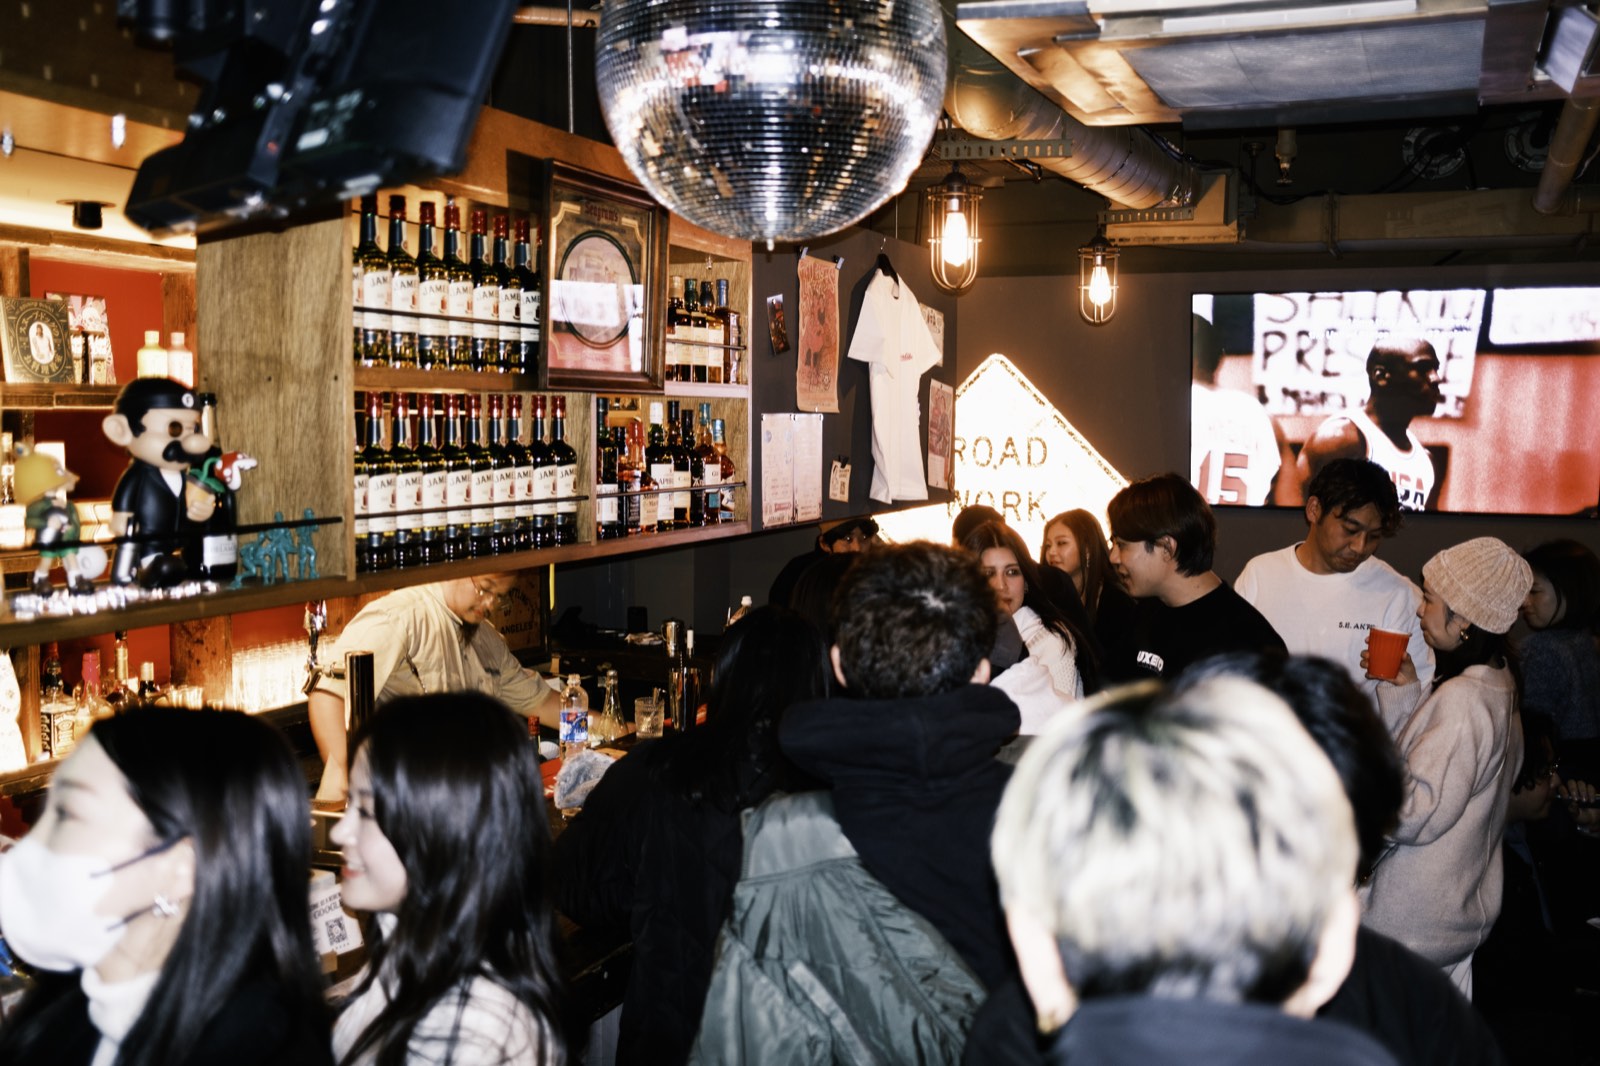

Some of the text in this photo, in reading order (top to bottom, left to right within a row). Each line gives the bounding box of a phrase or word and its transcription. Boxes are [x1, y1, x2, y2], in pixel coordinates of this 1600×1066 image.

[584, 201, 619, 222] Seagram's
[955, 436, 1047, 467] ROAD
[1197, 450, 1249, 505] 15
[1391, 471, 1424, 505] SA
[500, 621, 534, 635] ANGELES
[313, 900, 339, 919] GOOGL
